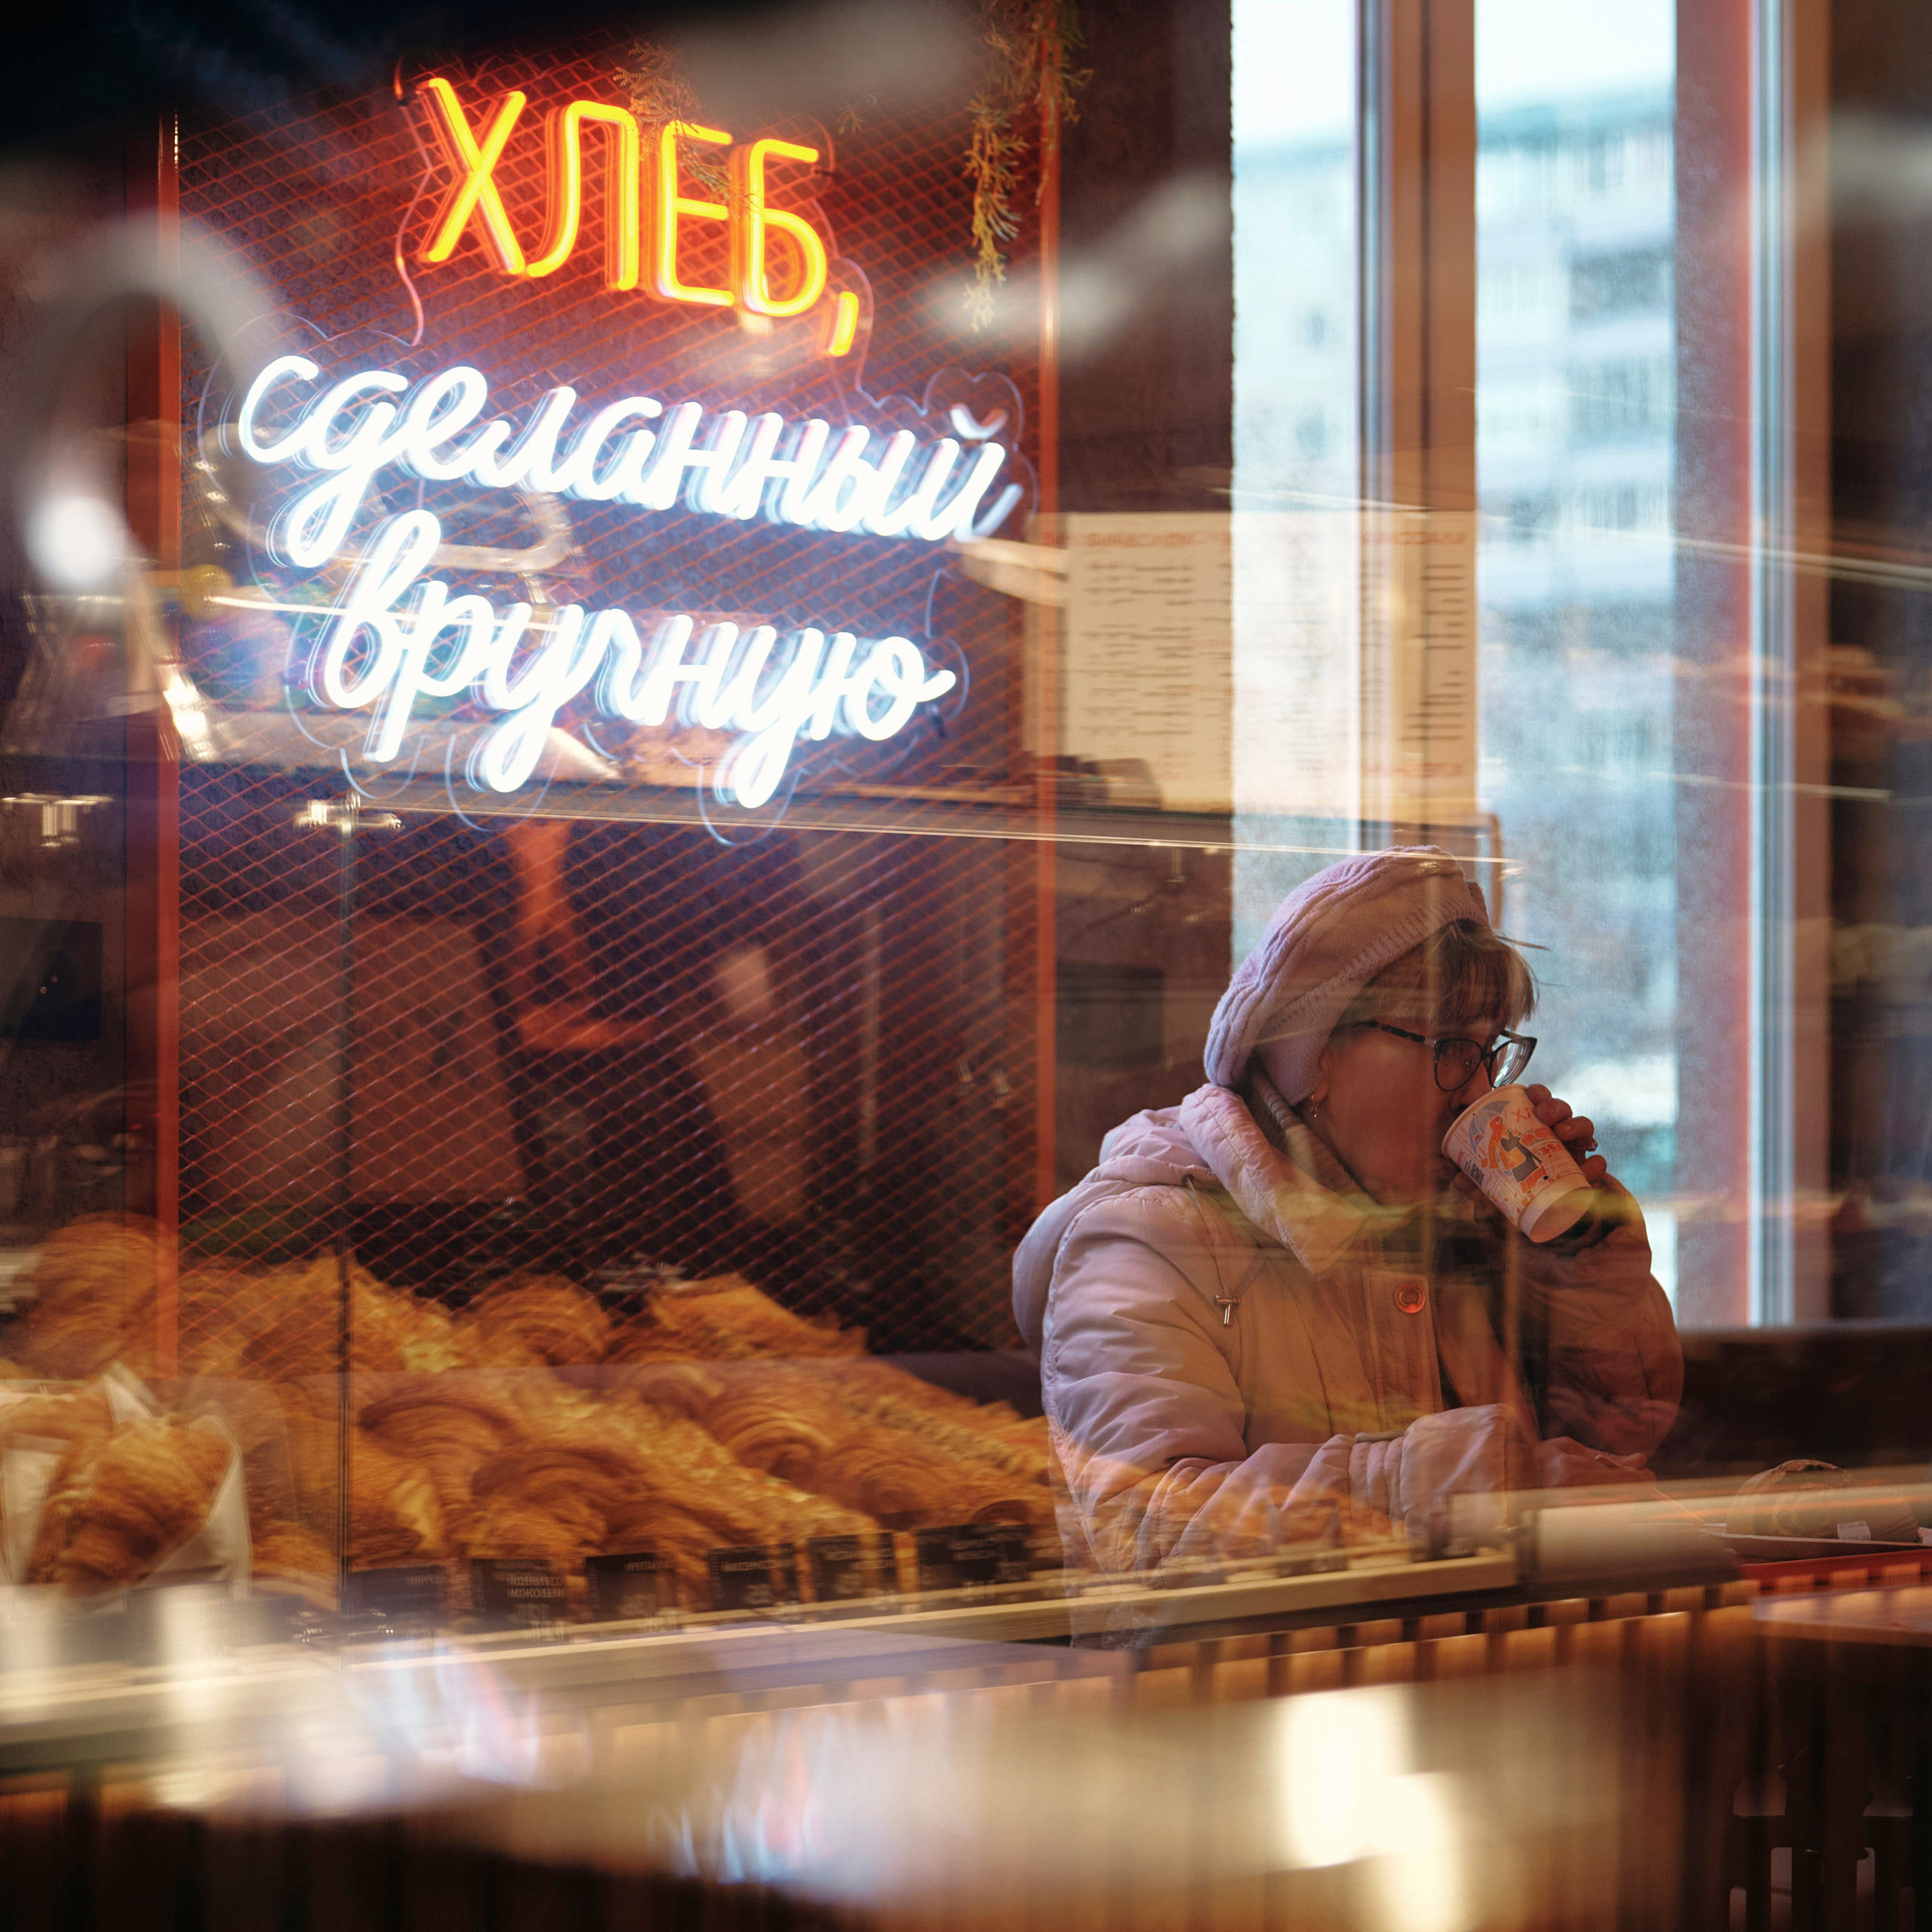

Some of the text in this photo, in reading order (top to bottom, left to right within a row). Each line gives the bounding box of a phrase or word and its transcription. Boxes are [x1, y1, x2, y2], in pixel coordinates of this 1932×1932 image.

[426, 77, 859, 357] ХЛЕБ,
[238, 355, 1022, 568] сделанный
[323, 509, 957, 808] вручную
